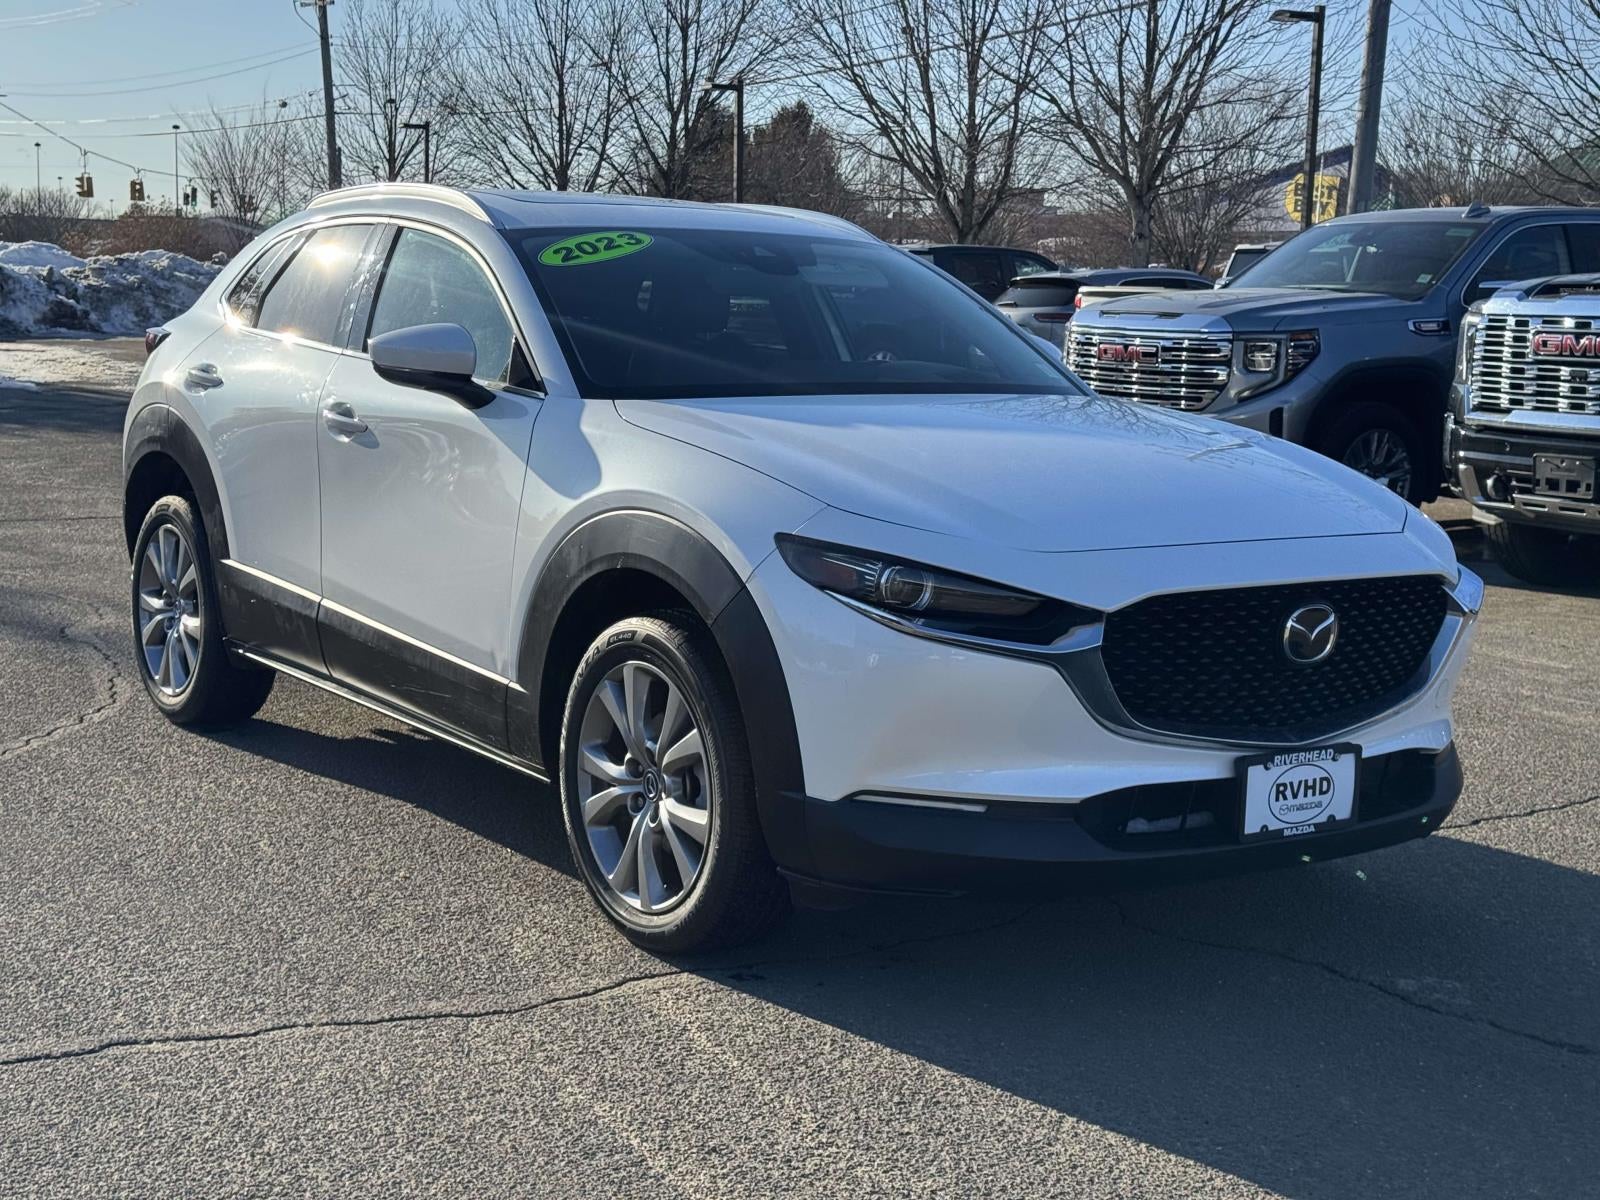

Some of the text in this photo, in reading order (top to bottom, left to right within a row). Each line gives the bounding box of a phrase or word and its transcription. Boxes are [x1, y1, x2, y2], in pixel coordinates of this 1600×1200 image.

[1294, 183, 1338, 200] BST
[553, 233, 644, 263] 2023
[1099, 344, 1157, 363] GMC
[1533, 334, 1600, 356] GM
[1274, 749, 1334, 767] RIVERHEAD
[1275, 776, 1331, 802] RVHD
[1284, 825, 1315, 837] MAZDA
